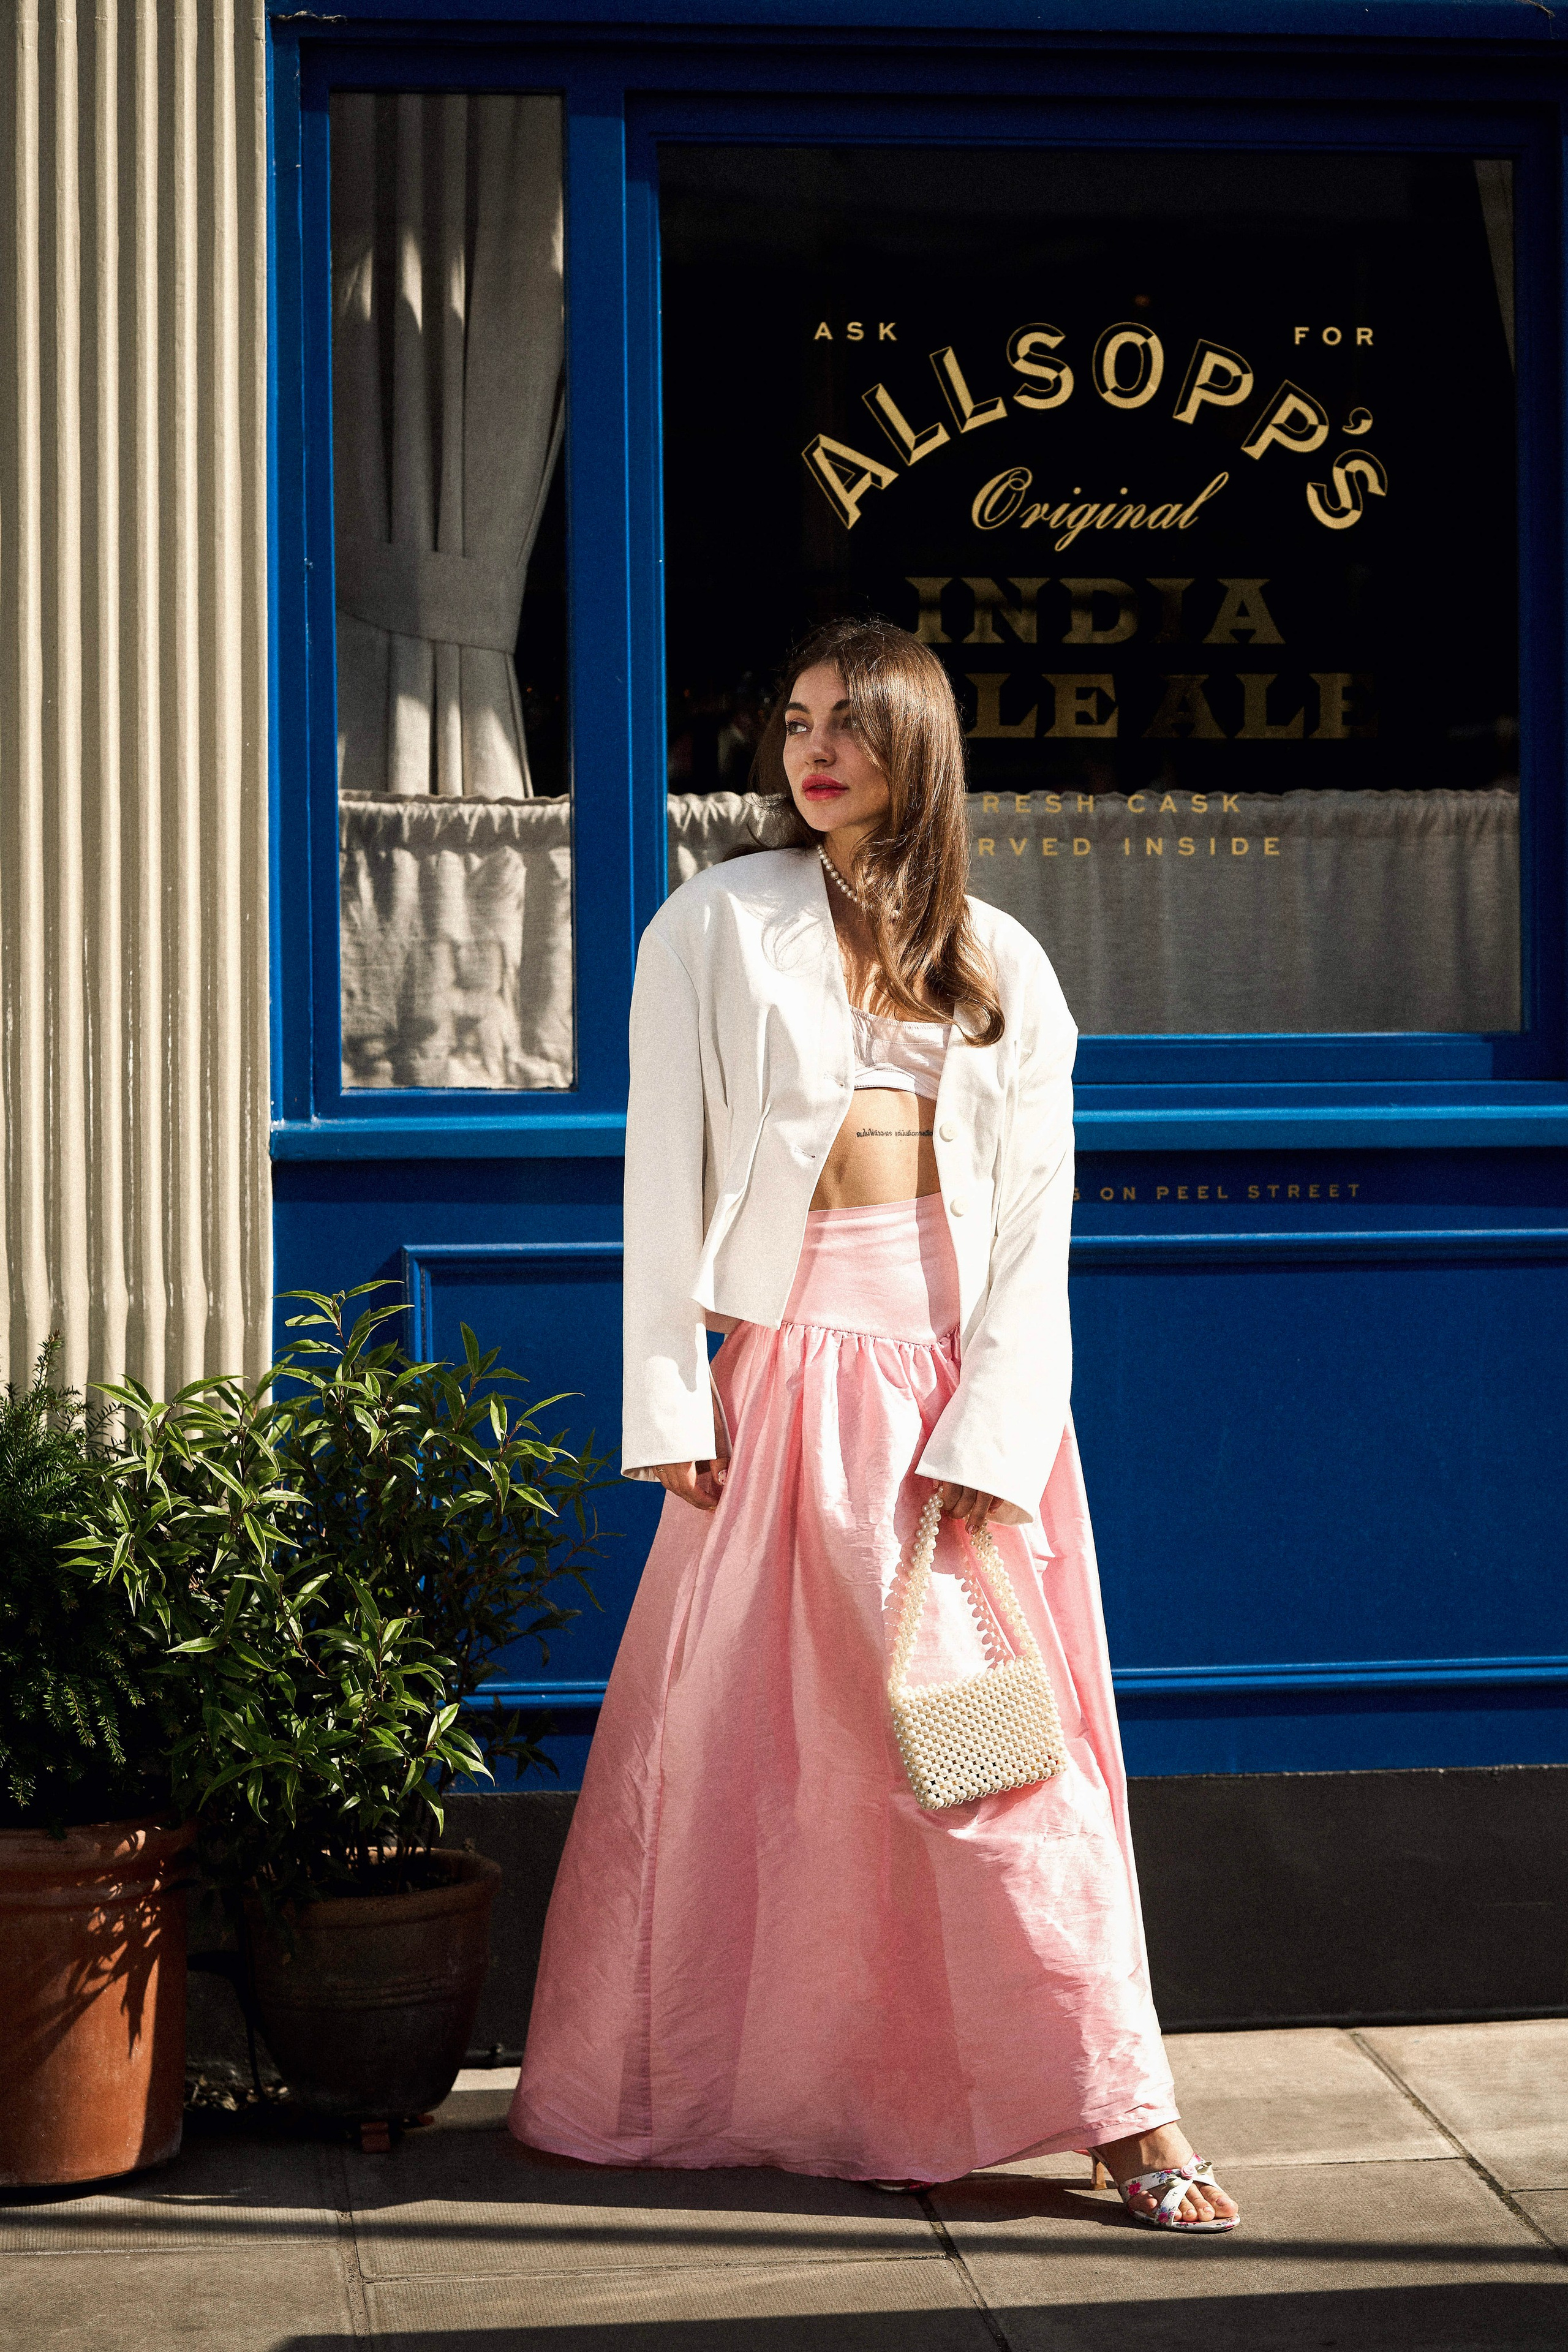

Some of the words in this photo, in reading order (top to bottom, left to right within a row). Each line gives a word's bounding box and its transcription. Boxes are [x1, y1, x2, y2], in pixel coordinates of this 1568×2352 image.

[813, 321, 898, 342] ASK
[1294, 326, 1374, 346] FOR
[971, 466, 1229, 552] Original
[905, 577, 1286, 645] INDIA
[964, 673, 1118, 739] LE
[1141, 673, 1379, 739] ALE
[981, 794, 1095, 814] RESH
[1127, 794, 1241, 814] CASK
[978, 837, 1092, 857] RVED
[1123, 836, 1281, 856] INSIDE
[1099, 1186, 1136, 1201] ON
[1156, 1185, 1229, 1200] PEEL
[1248, 1183, 1360, 1199] STREET
